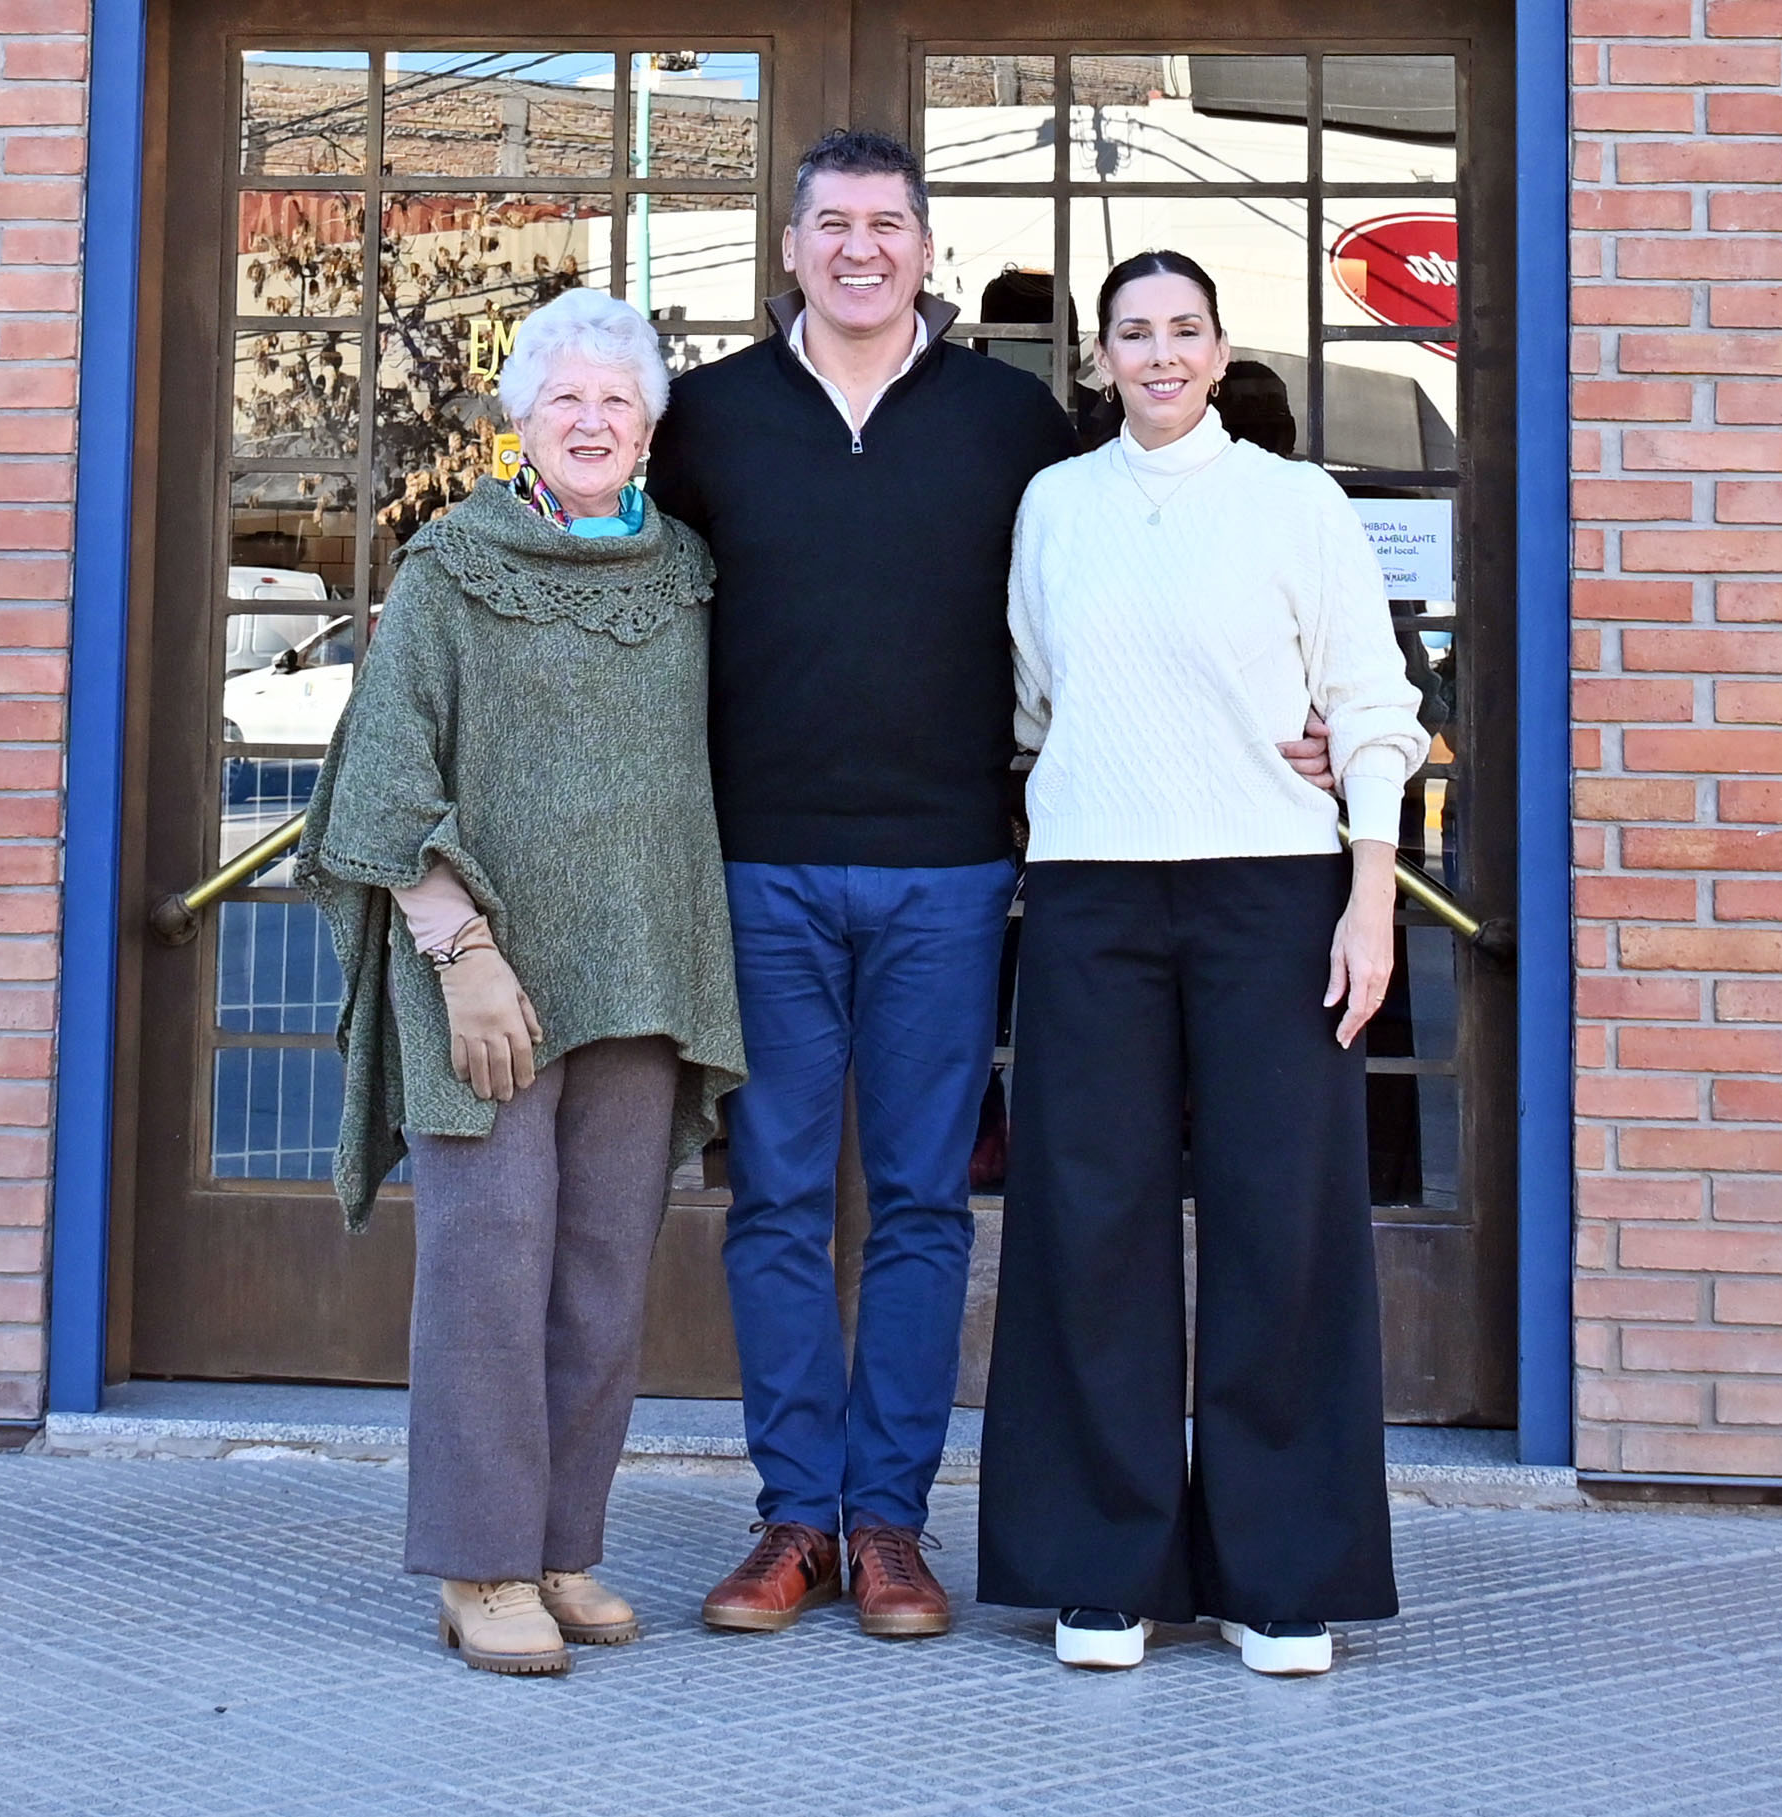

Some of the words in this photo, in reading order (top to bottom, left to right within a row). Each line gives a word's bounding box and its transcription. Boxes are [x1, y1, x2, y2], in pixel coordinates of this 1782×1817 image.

[1361, 522, 1396, 532] HIBIDA
[1398, 522, 1408, 532] la
[1377, 546, 1392, 555] del
